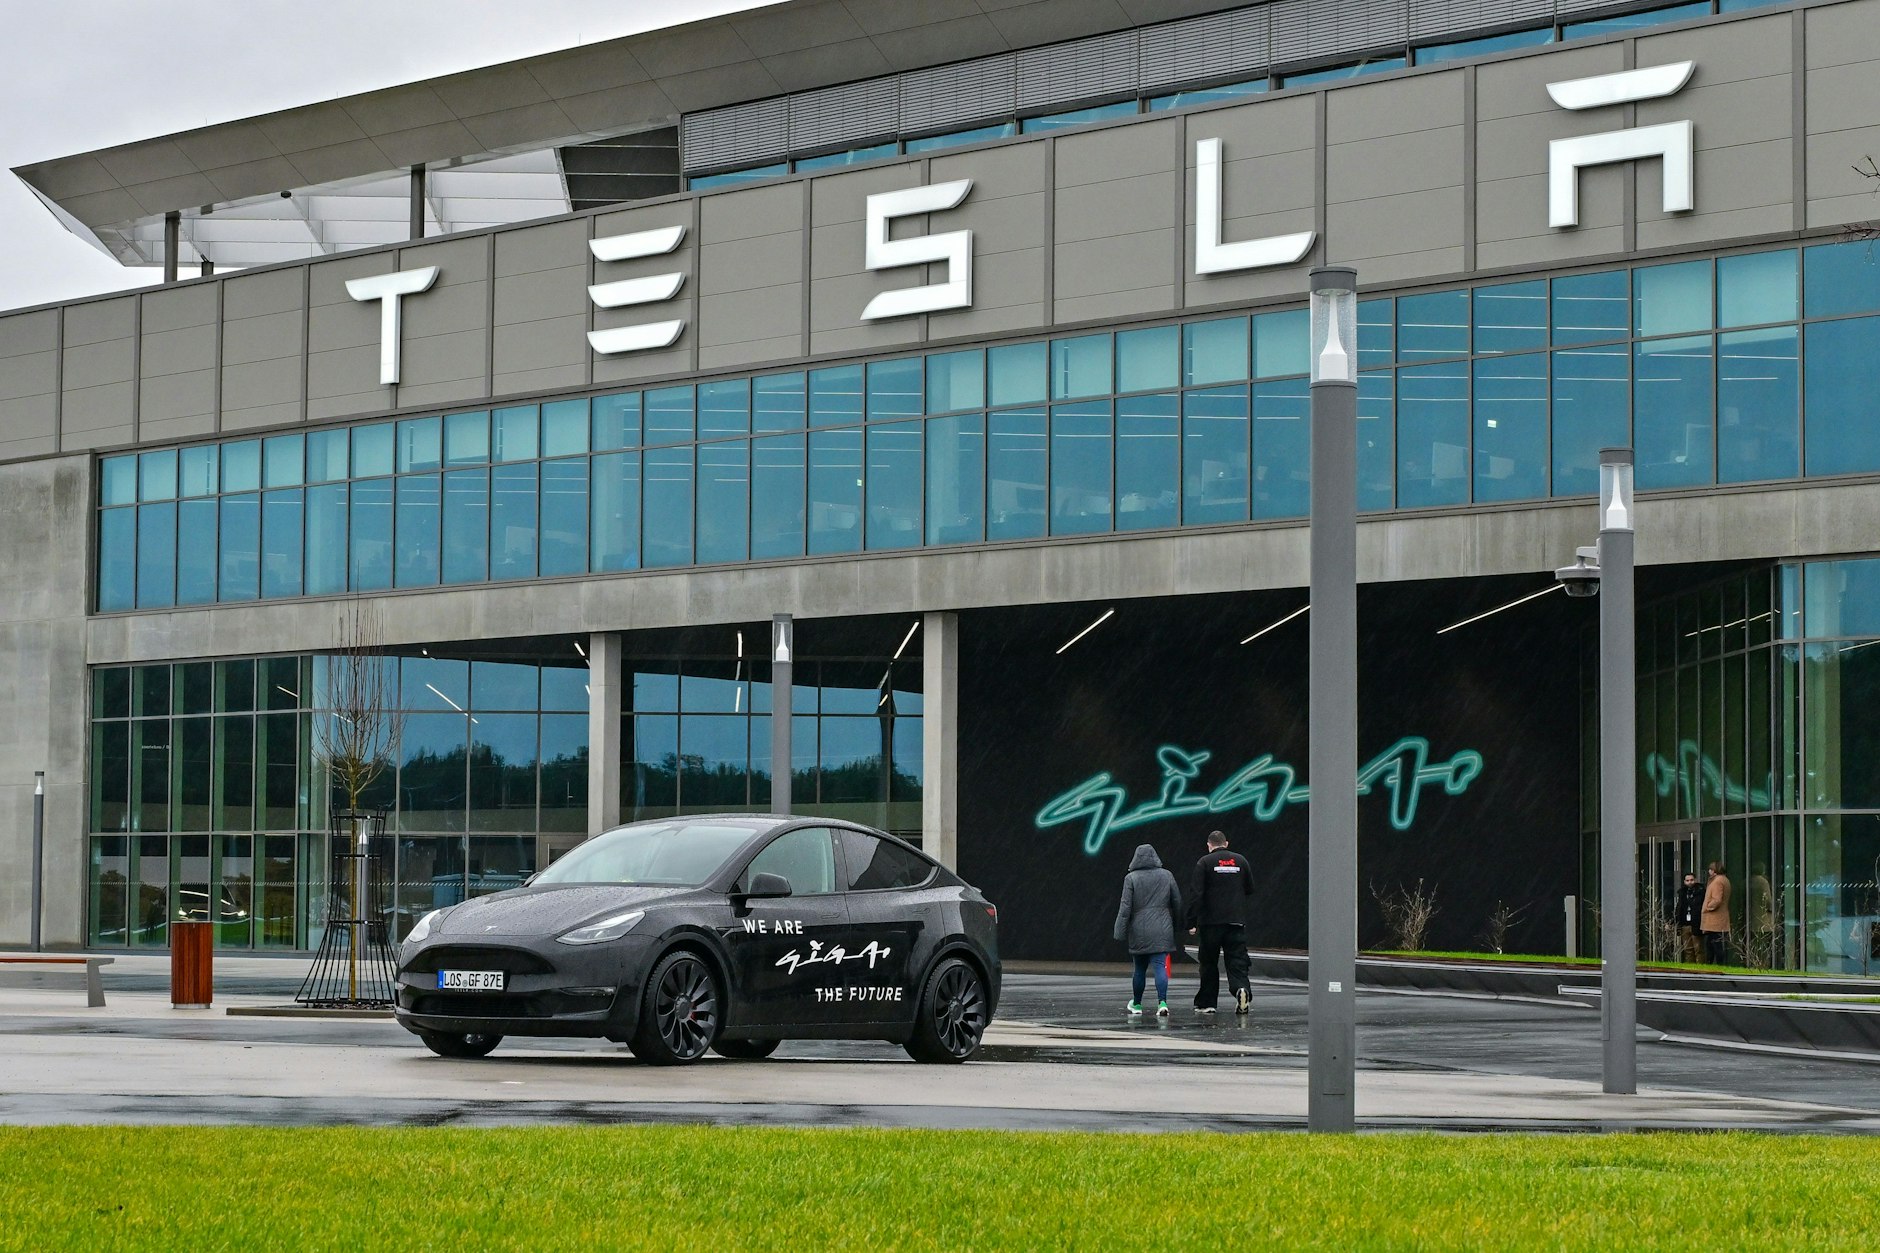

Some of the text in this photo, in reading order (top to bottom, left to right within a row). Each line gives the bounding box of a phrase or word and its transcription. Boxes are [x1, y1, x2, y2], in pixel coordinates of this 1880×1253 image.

[345, 60, 1696, 385] TESLA
[743, 919, 804, 935] WE ARE
[444, 973, 502, 987] LOS GF 87E
[815, 987, 902, 1002] THE FUTURE
